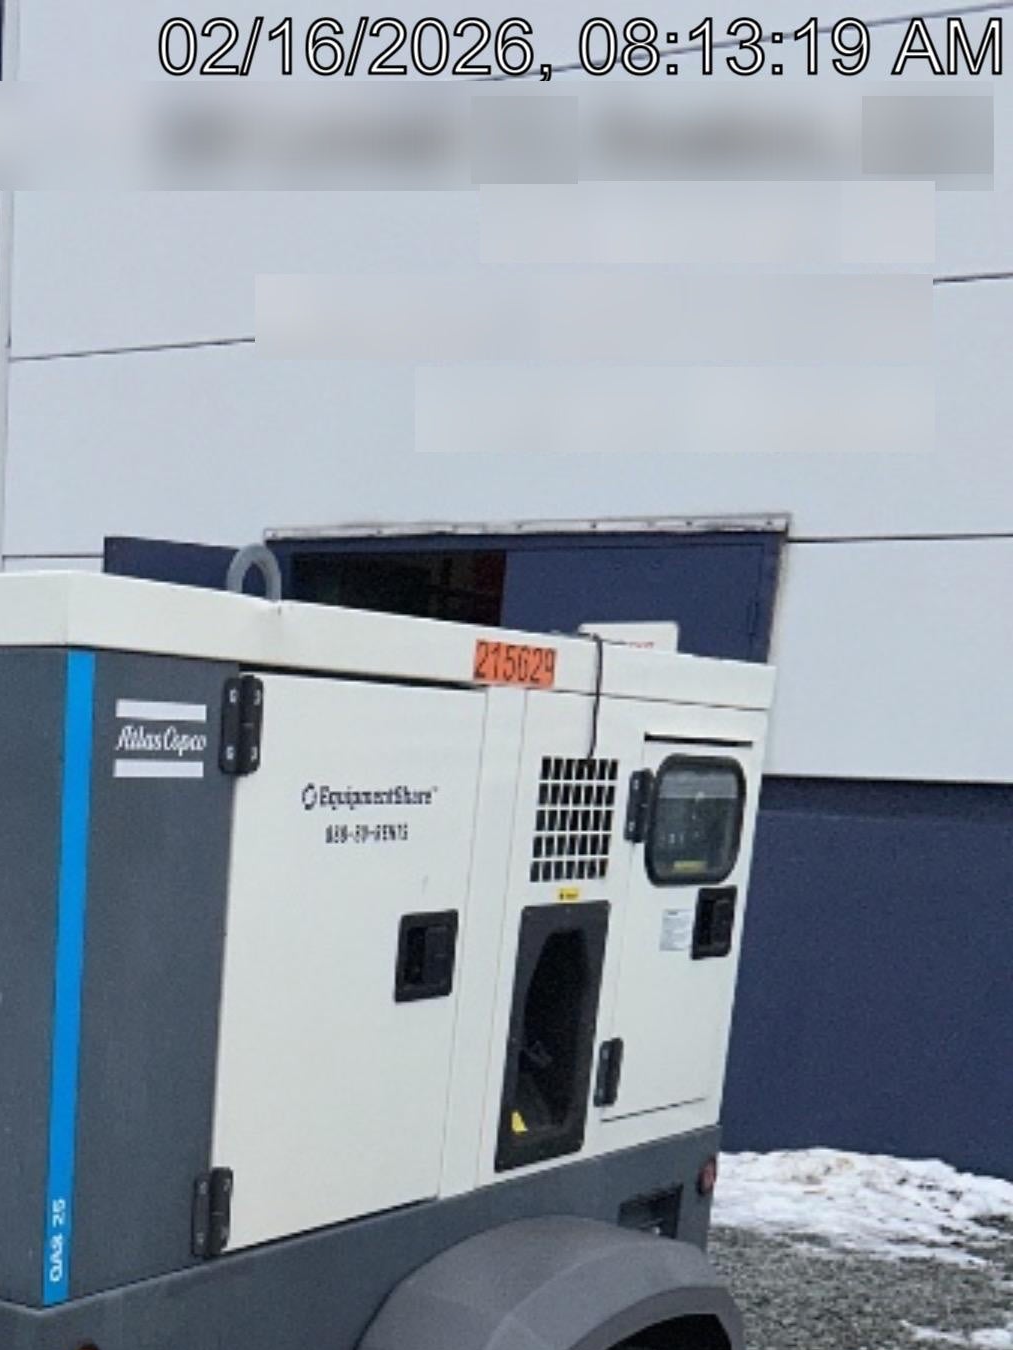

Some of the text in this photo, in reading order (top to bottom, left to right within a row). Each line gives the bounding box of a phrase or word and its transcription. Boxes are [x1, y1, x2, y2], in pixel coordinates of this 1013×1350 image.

[475, 640, 555, 685] 215629
[115, 725, 207, 756] Atlas Copco
[319, 784, 434, 811] EquipmentShare
[51, 1198, 67, 1228] 25
